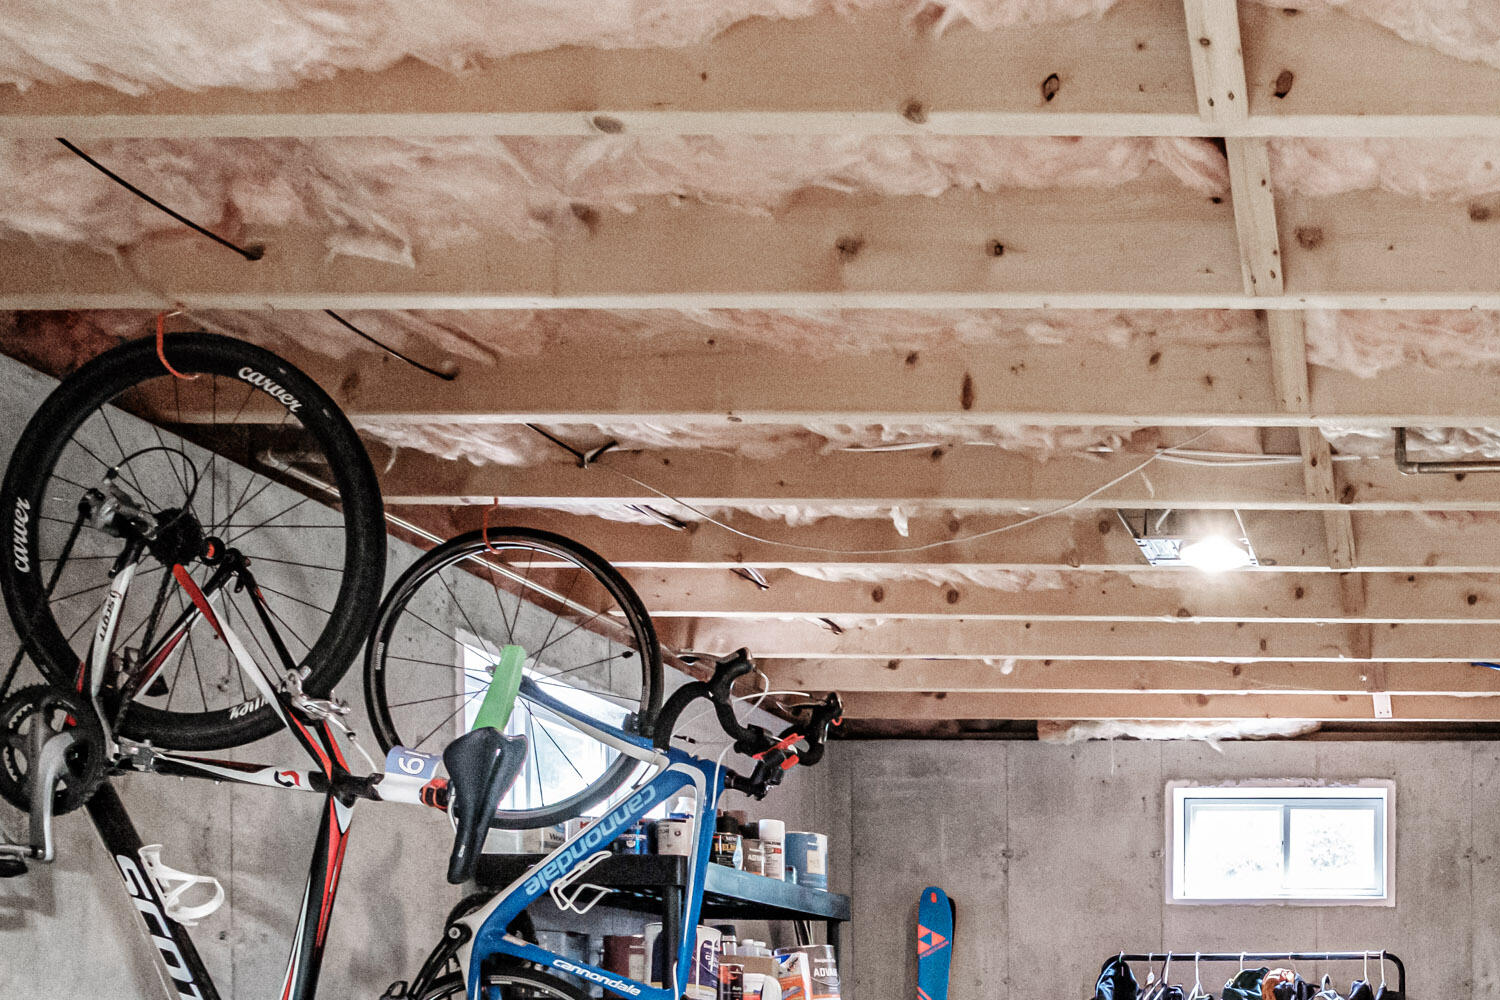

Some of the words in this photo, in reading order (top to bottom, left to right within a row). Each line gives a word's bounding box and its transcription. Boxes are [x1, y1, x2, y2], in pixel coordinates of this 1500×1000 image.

[238, 366, 303, 413] carver
[14, 496, 32, 574] carver
[524, 784, 656, 896] cannondale
[552, 958, 641, 996] cannondale
